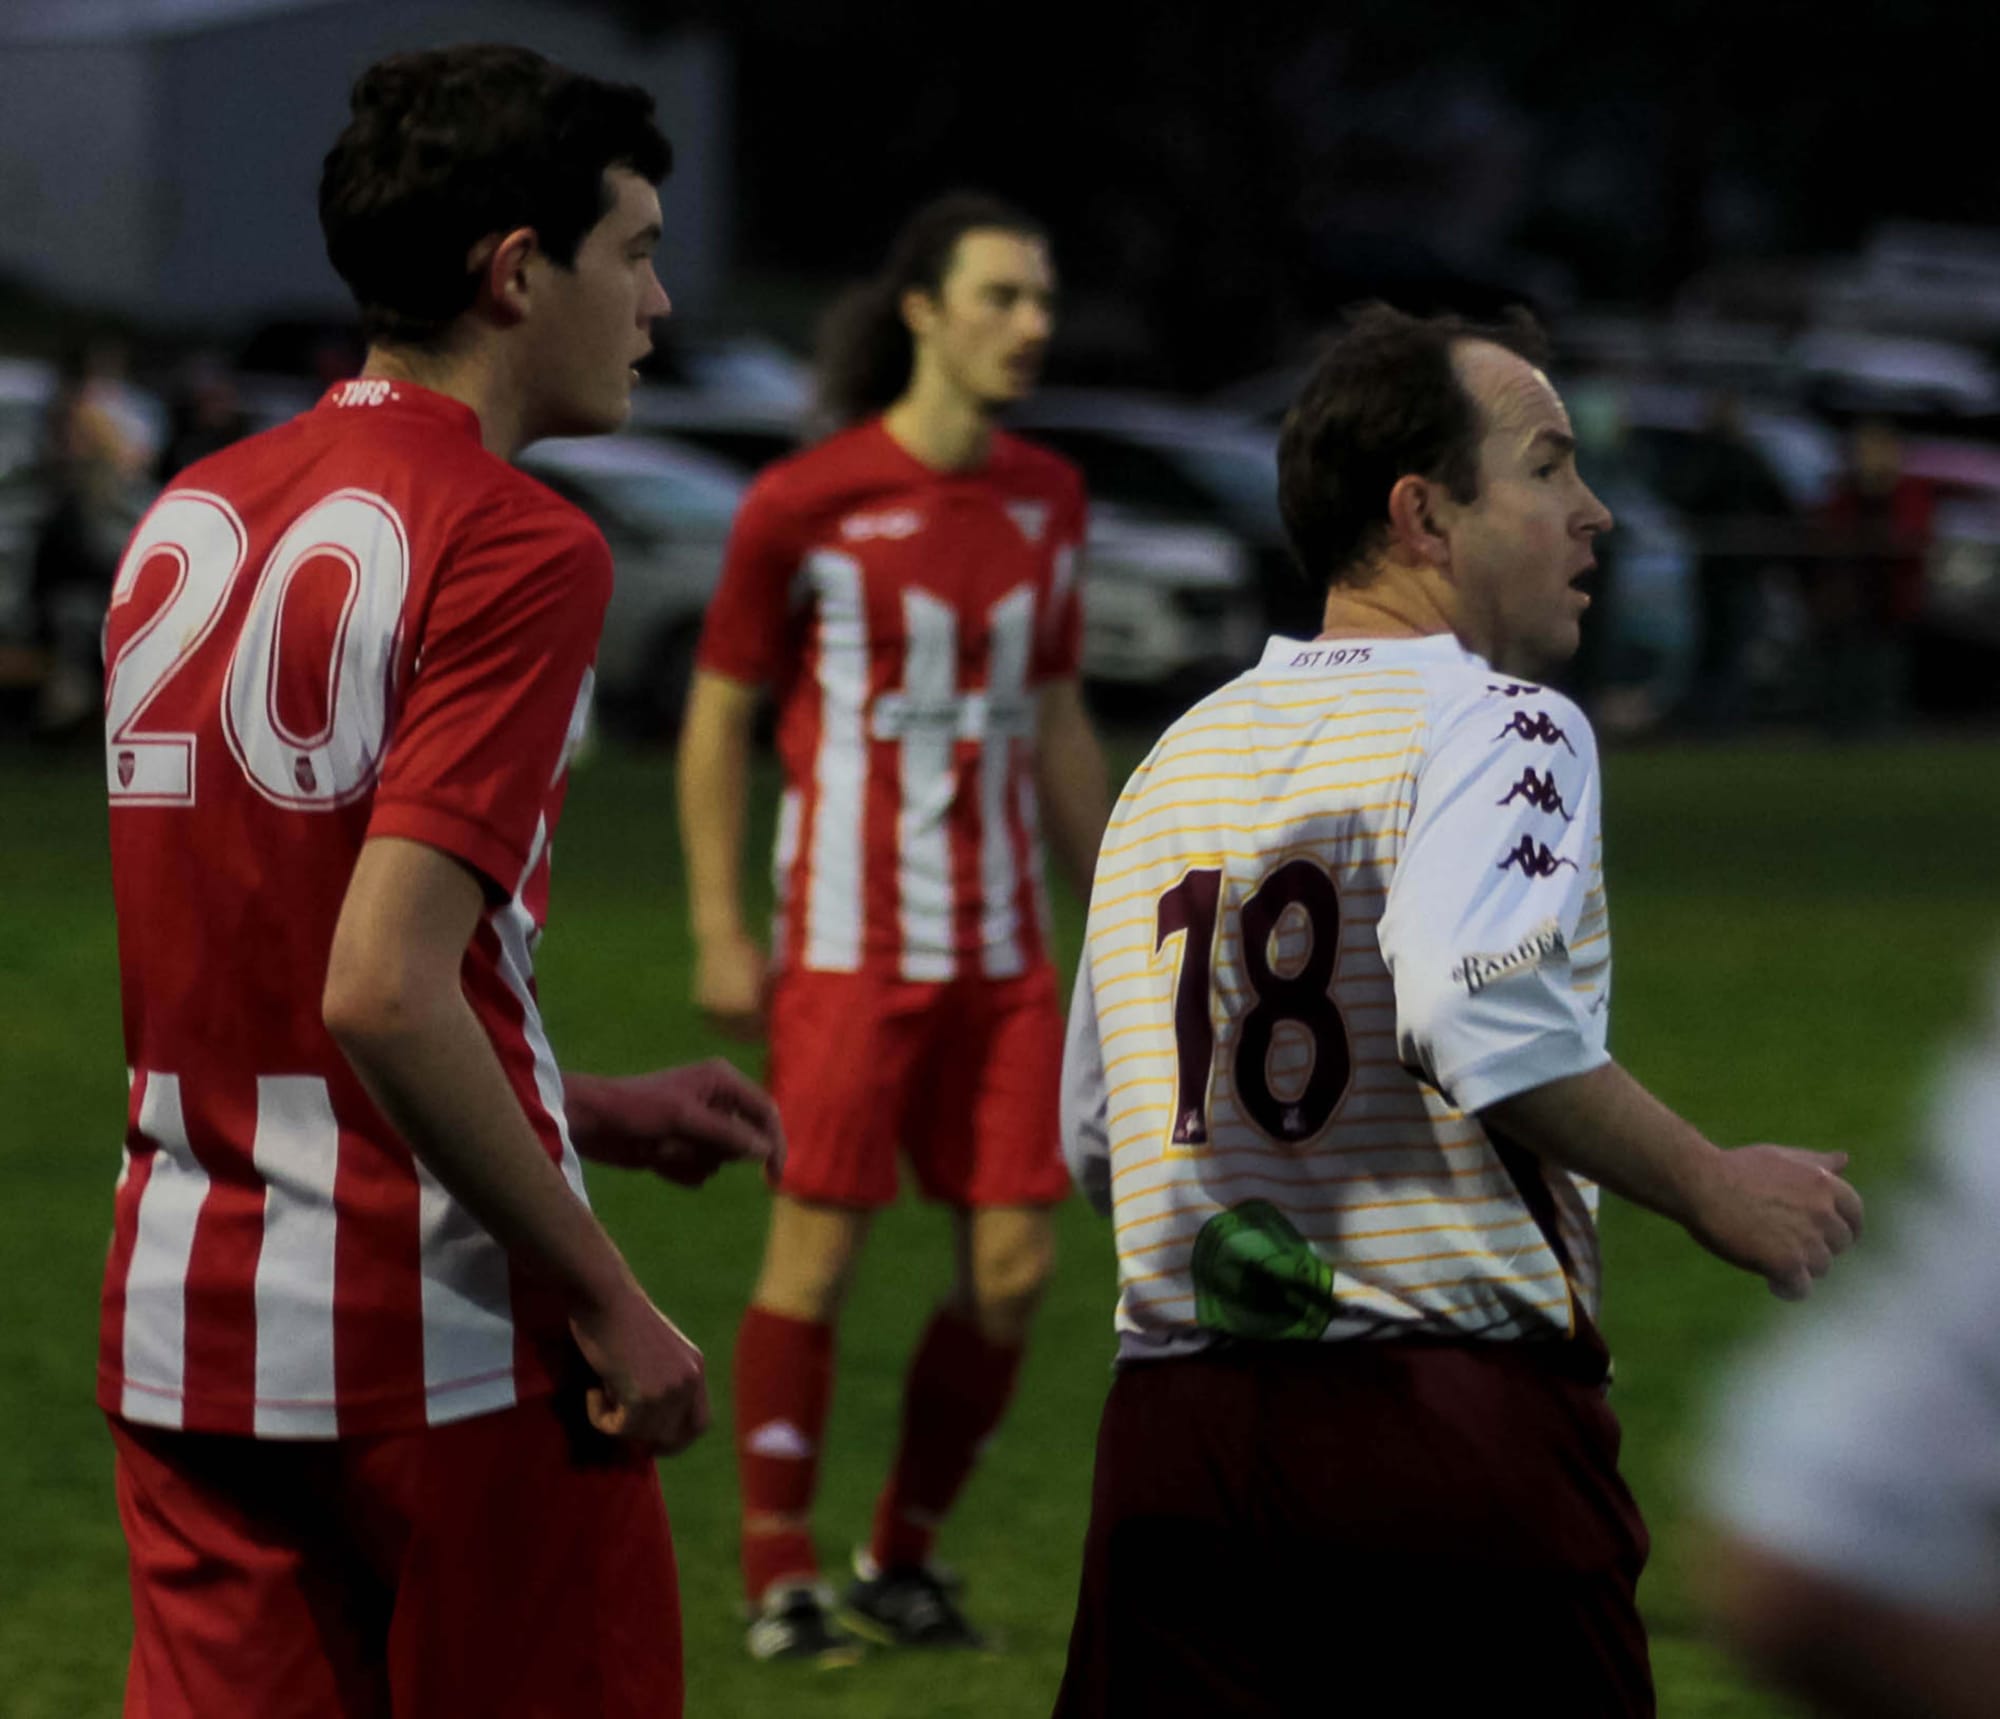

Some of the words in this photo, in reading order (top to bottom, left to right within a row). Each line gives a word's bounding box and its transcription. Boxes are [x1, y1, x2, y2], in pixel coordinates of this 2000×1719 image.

[104, 487, 411, 811] 20
[1290, 651, 1325, 667] EST
[1325, 647, 1374, 666] 1975
[1153, 856, 1352, 1146] 18
